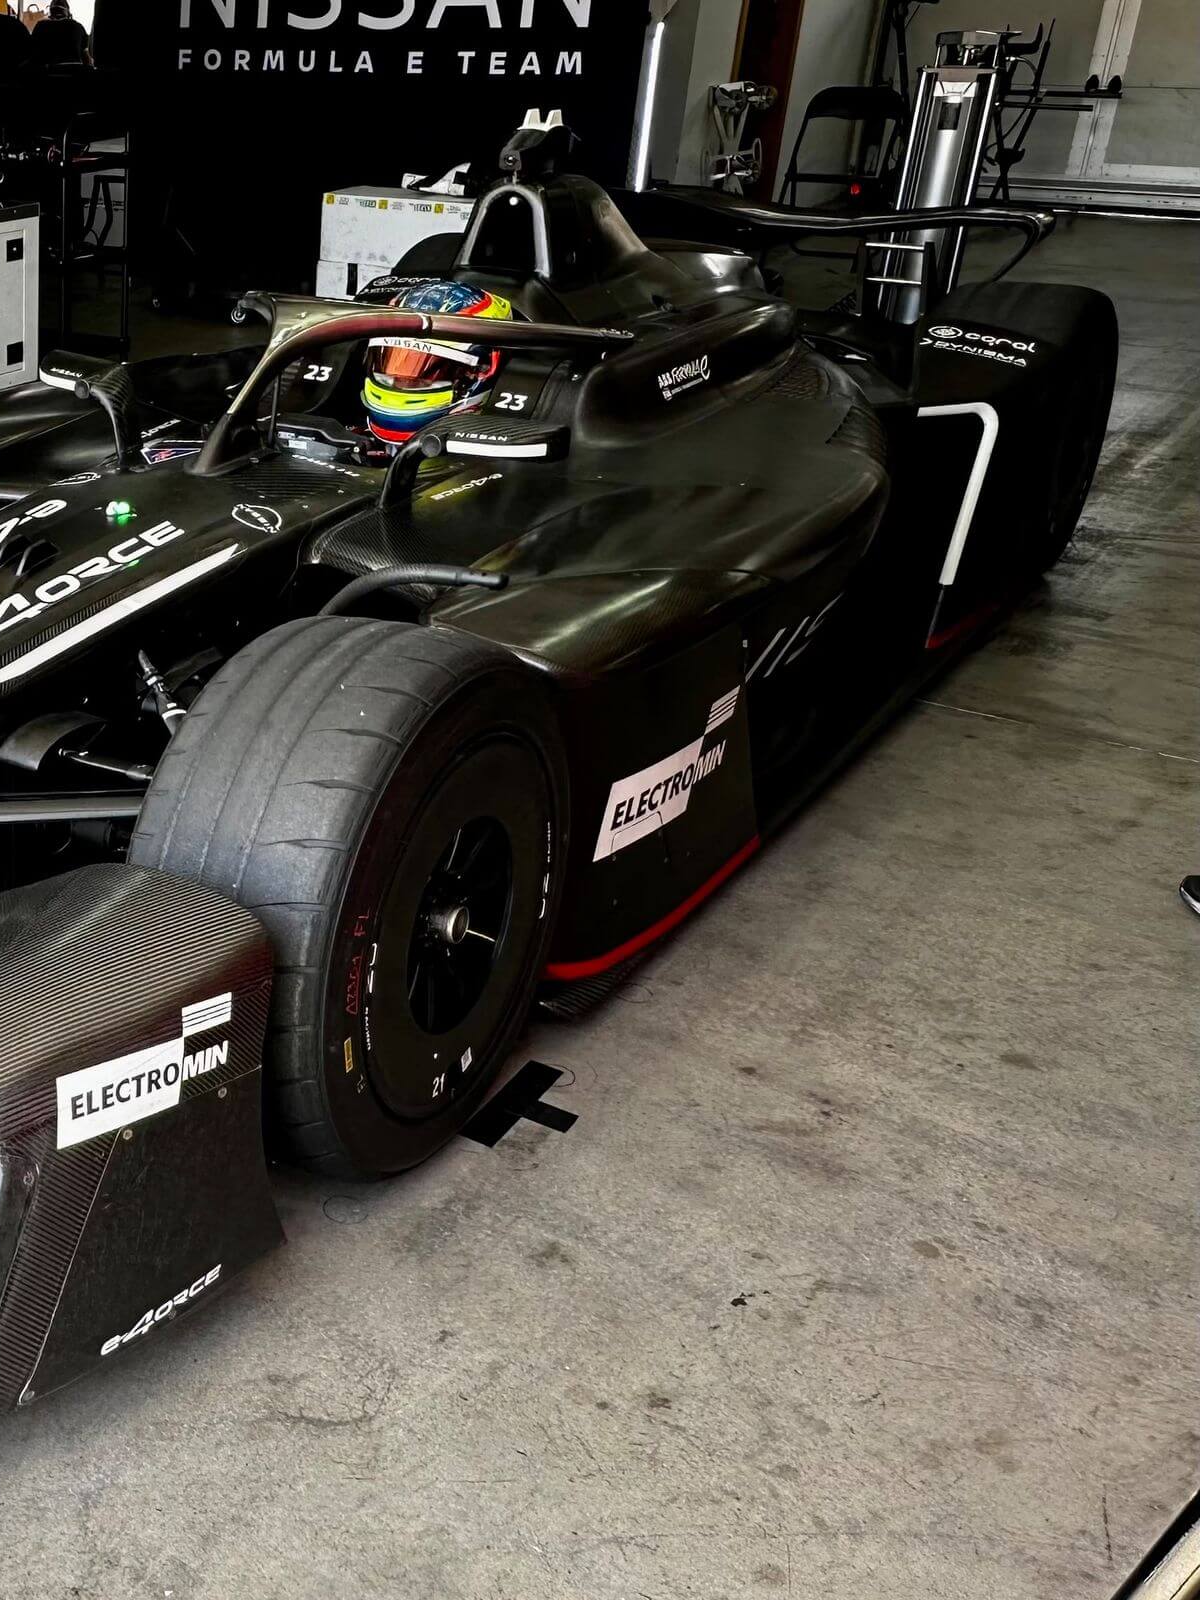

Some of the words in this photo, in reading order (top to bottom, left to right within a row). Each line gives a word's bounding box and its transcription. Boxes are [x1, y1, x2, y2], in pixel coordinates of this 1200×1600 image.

[178, 49, 375, 74] FORMULA
[406, 51, 424, 74] E
[457, 51, 583, 75] TEAM
[964, 332, 1036, 353] coral
[303, 364, 333, 382] 23
[494, 392, 528, 411] 23
[454, 432, 508, 442] NISSAN
